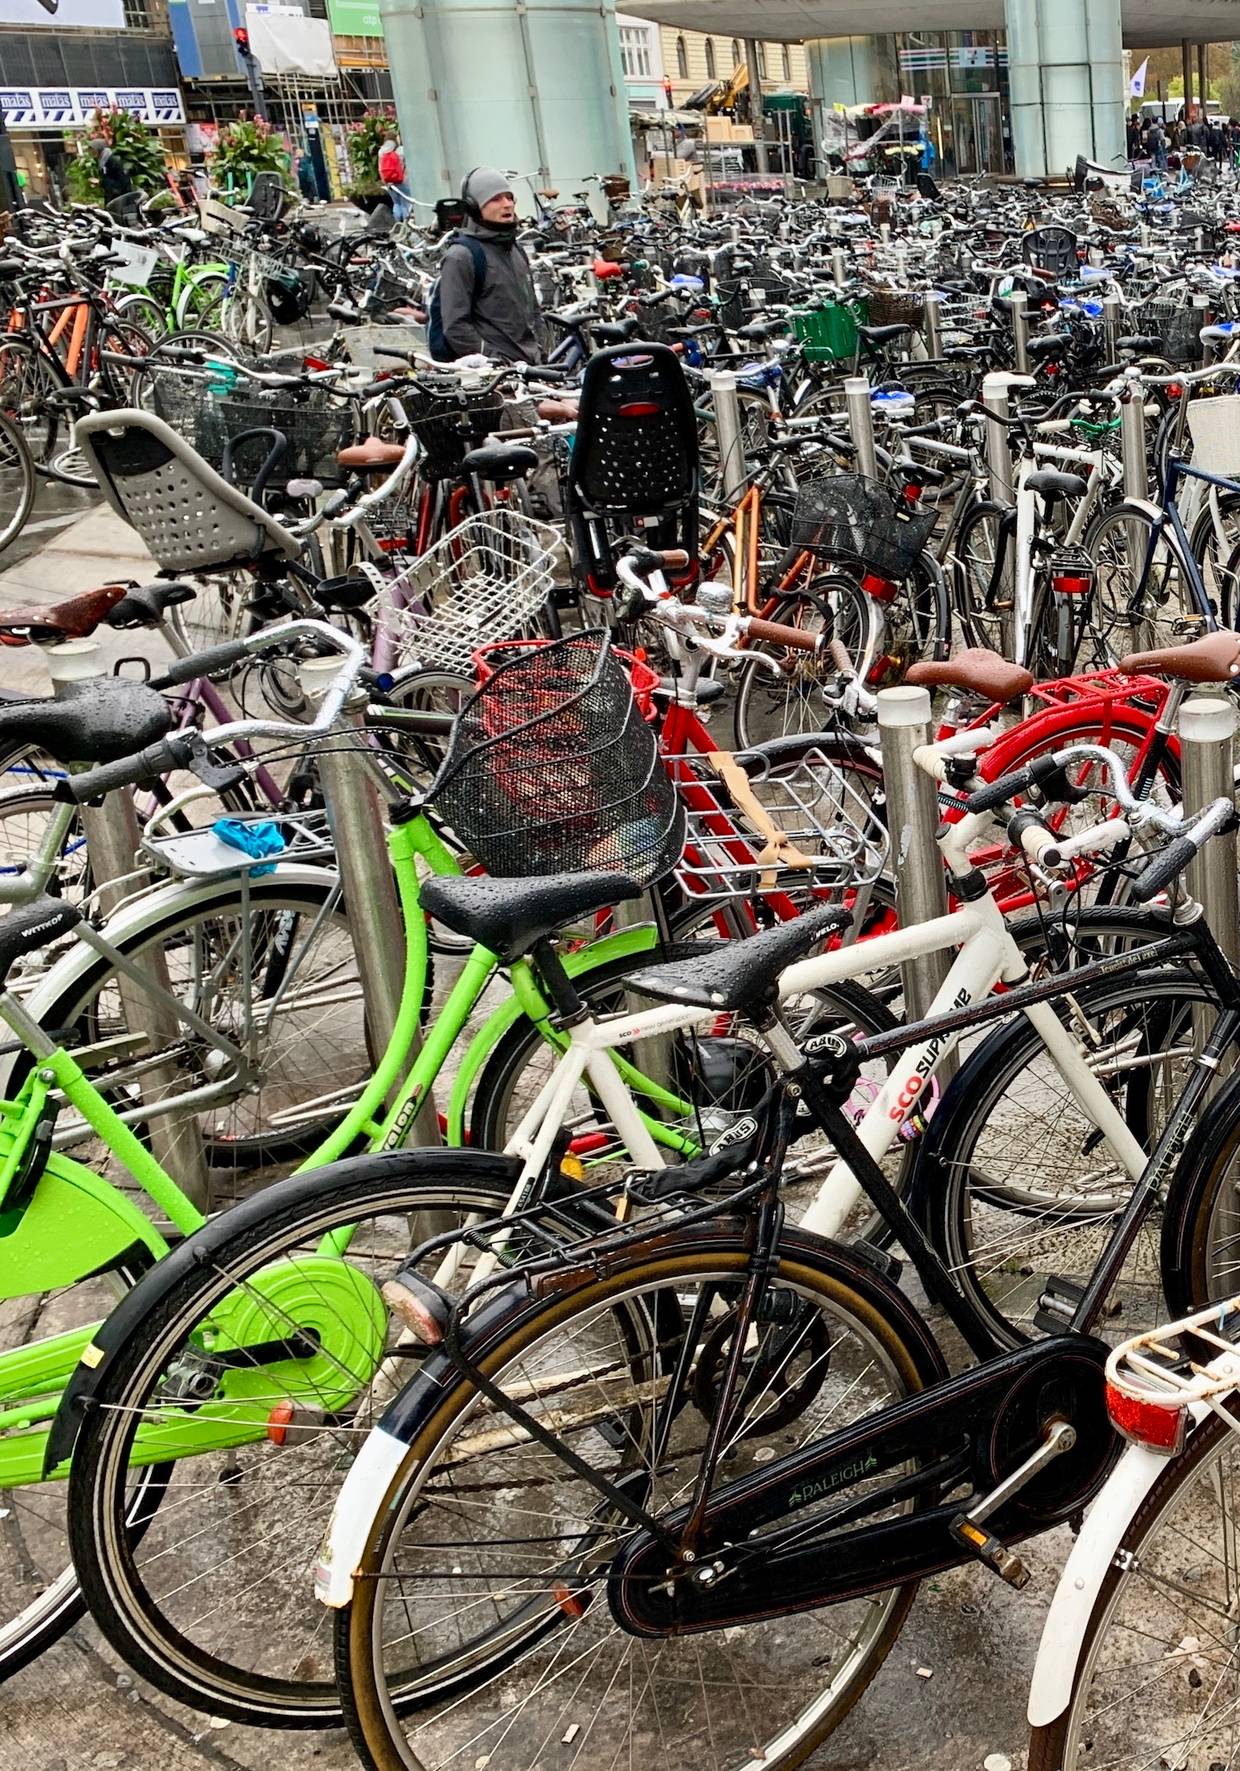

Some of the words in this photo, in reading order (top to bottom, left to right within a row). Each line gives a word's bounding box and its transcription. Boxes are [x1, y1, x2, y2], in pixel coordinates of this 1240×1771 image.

[42, 94, 70, 107] matas
[21, 913, 63, 938] WITTKOP
[889, 1076, 923, 1122] SCO
[915, 987, 972, 1079] SUPRME
[716, 1122, 751, 1151] ABUS
[802, 1460, 865, 1501] RALEIGH
